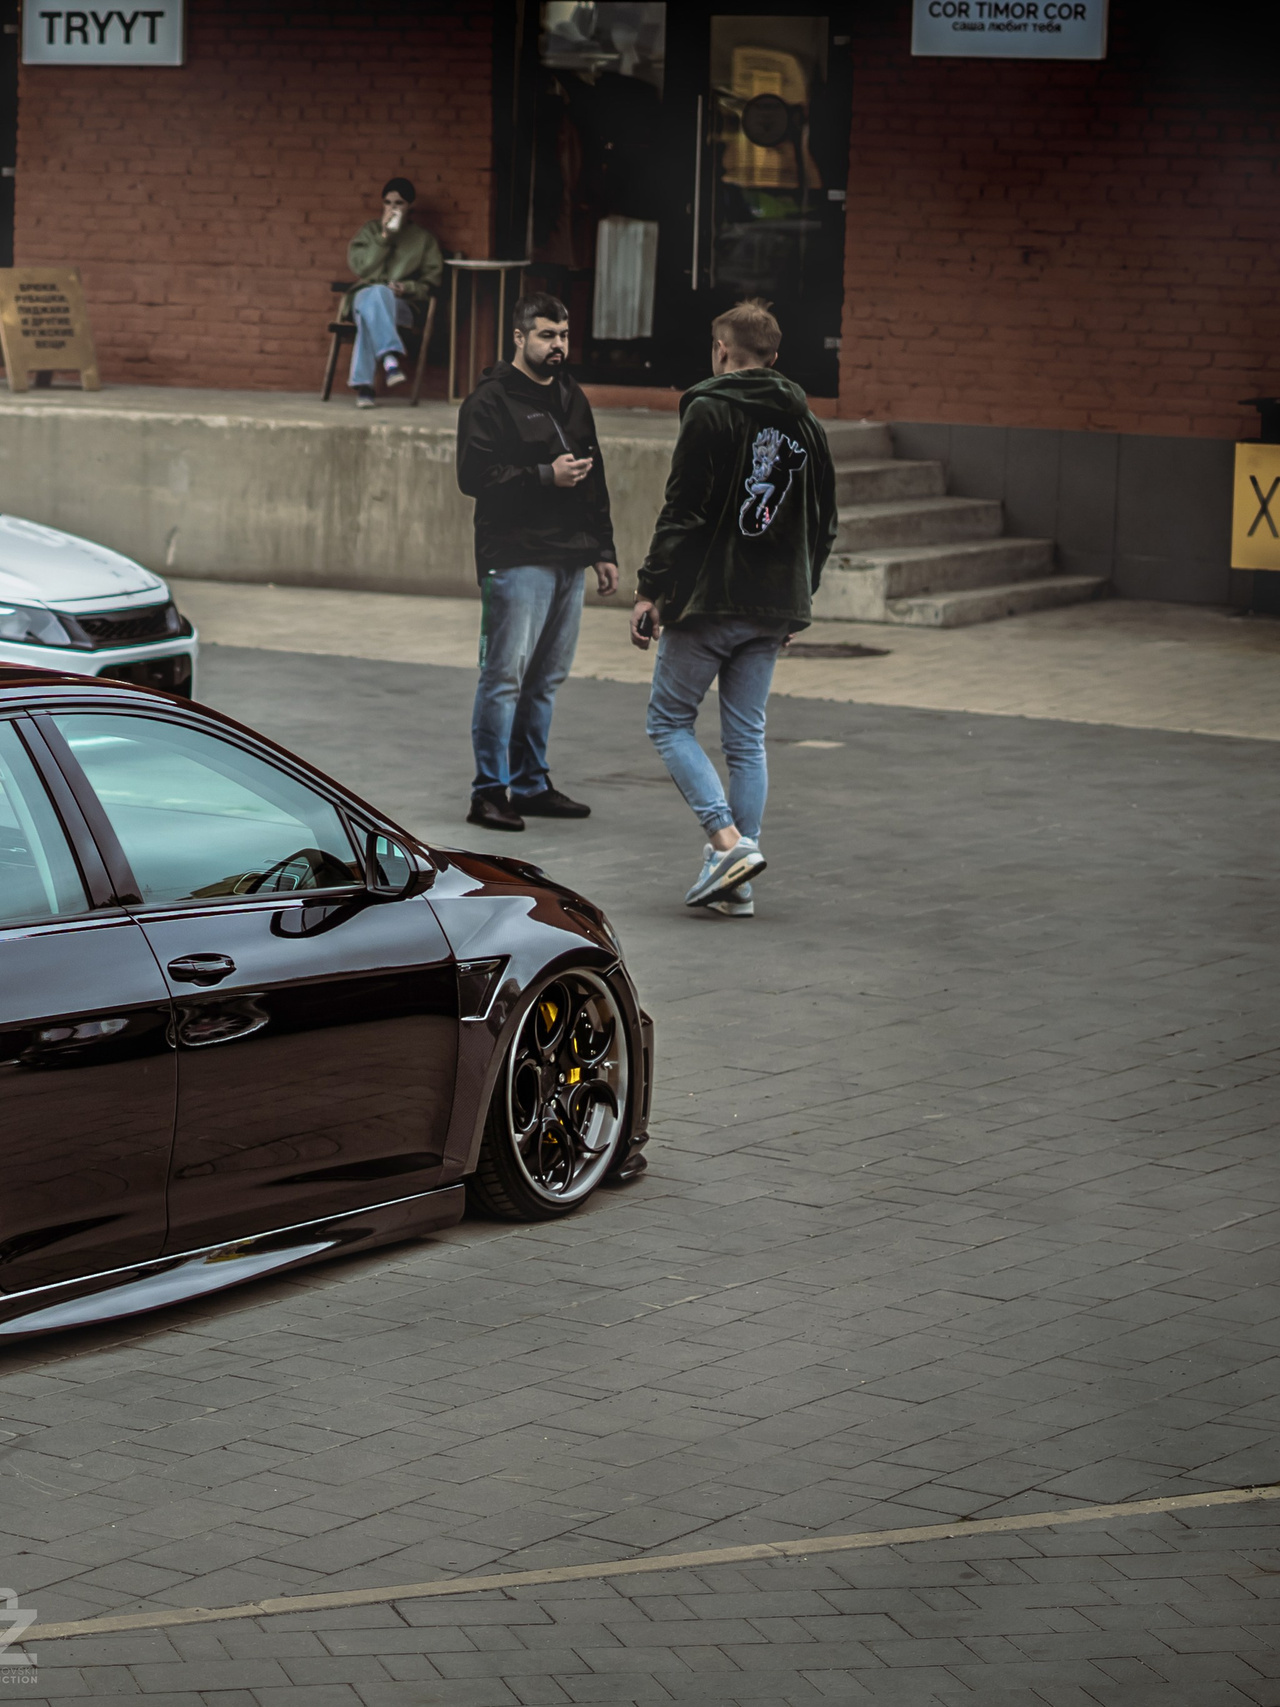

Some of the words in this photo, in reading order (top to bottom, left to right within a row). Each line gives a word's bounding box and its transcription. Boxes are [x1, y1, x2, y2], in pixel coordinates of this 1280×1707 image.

[928, 1, 970, 18] COR
[975, 2, 1038, 20] TIMOR
[1044, 3, 1086, 21] COR
[39, 11, 165, 45] TRYYT
[952, 21, 984, 32] саша
[988, 20, 1027, 32] любит
[1032, 21, 1062, 33] тебя
